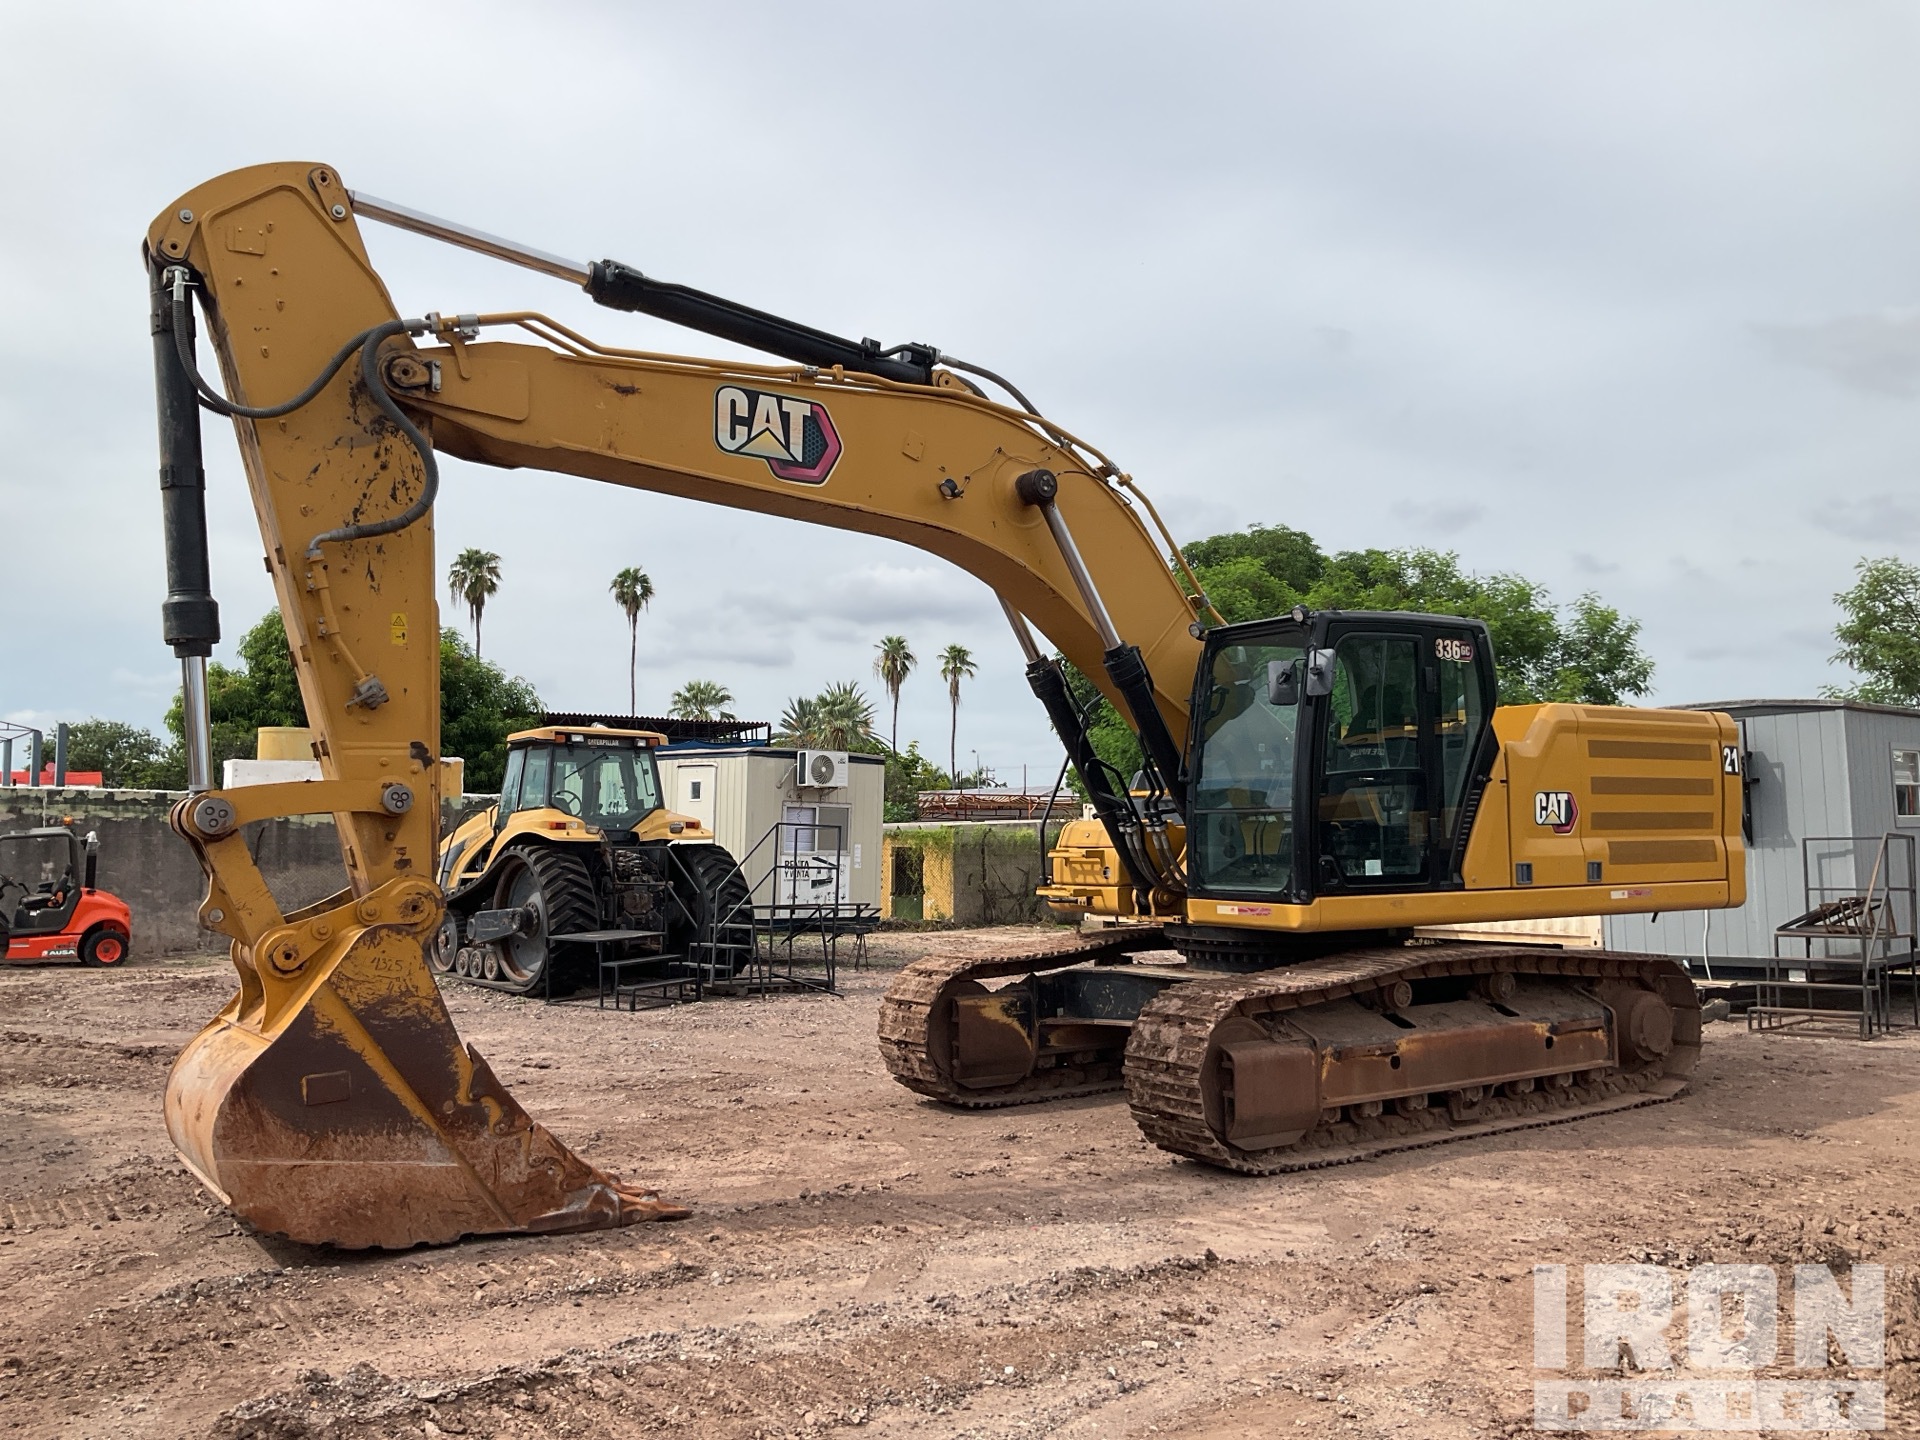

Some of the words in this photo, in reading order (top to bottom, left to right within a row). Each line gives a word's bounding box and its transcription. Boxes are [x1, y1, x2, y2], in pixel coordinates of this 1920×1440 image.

[717, 387, 811, 463] CAT
[1435, 639, 1460, 659] 336
[1723, 747, 1739, 773] 21
[1535, 792, 1569, 825] CAT
[790, 870, 810, 878] VNTA
